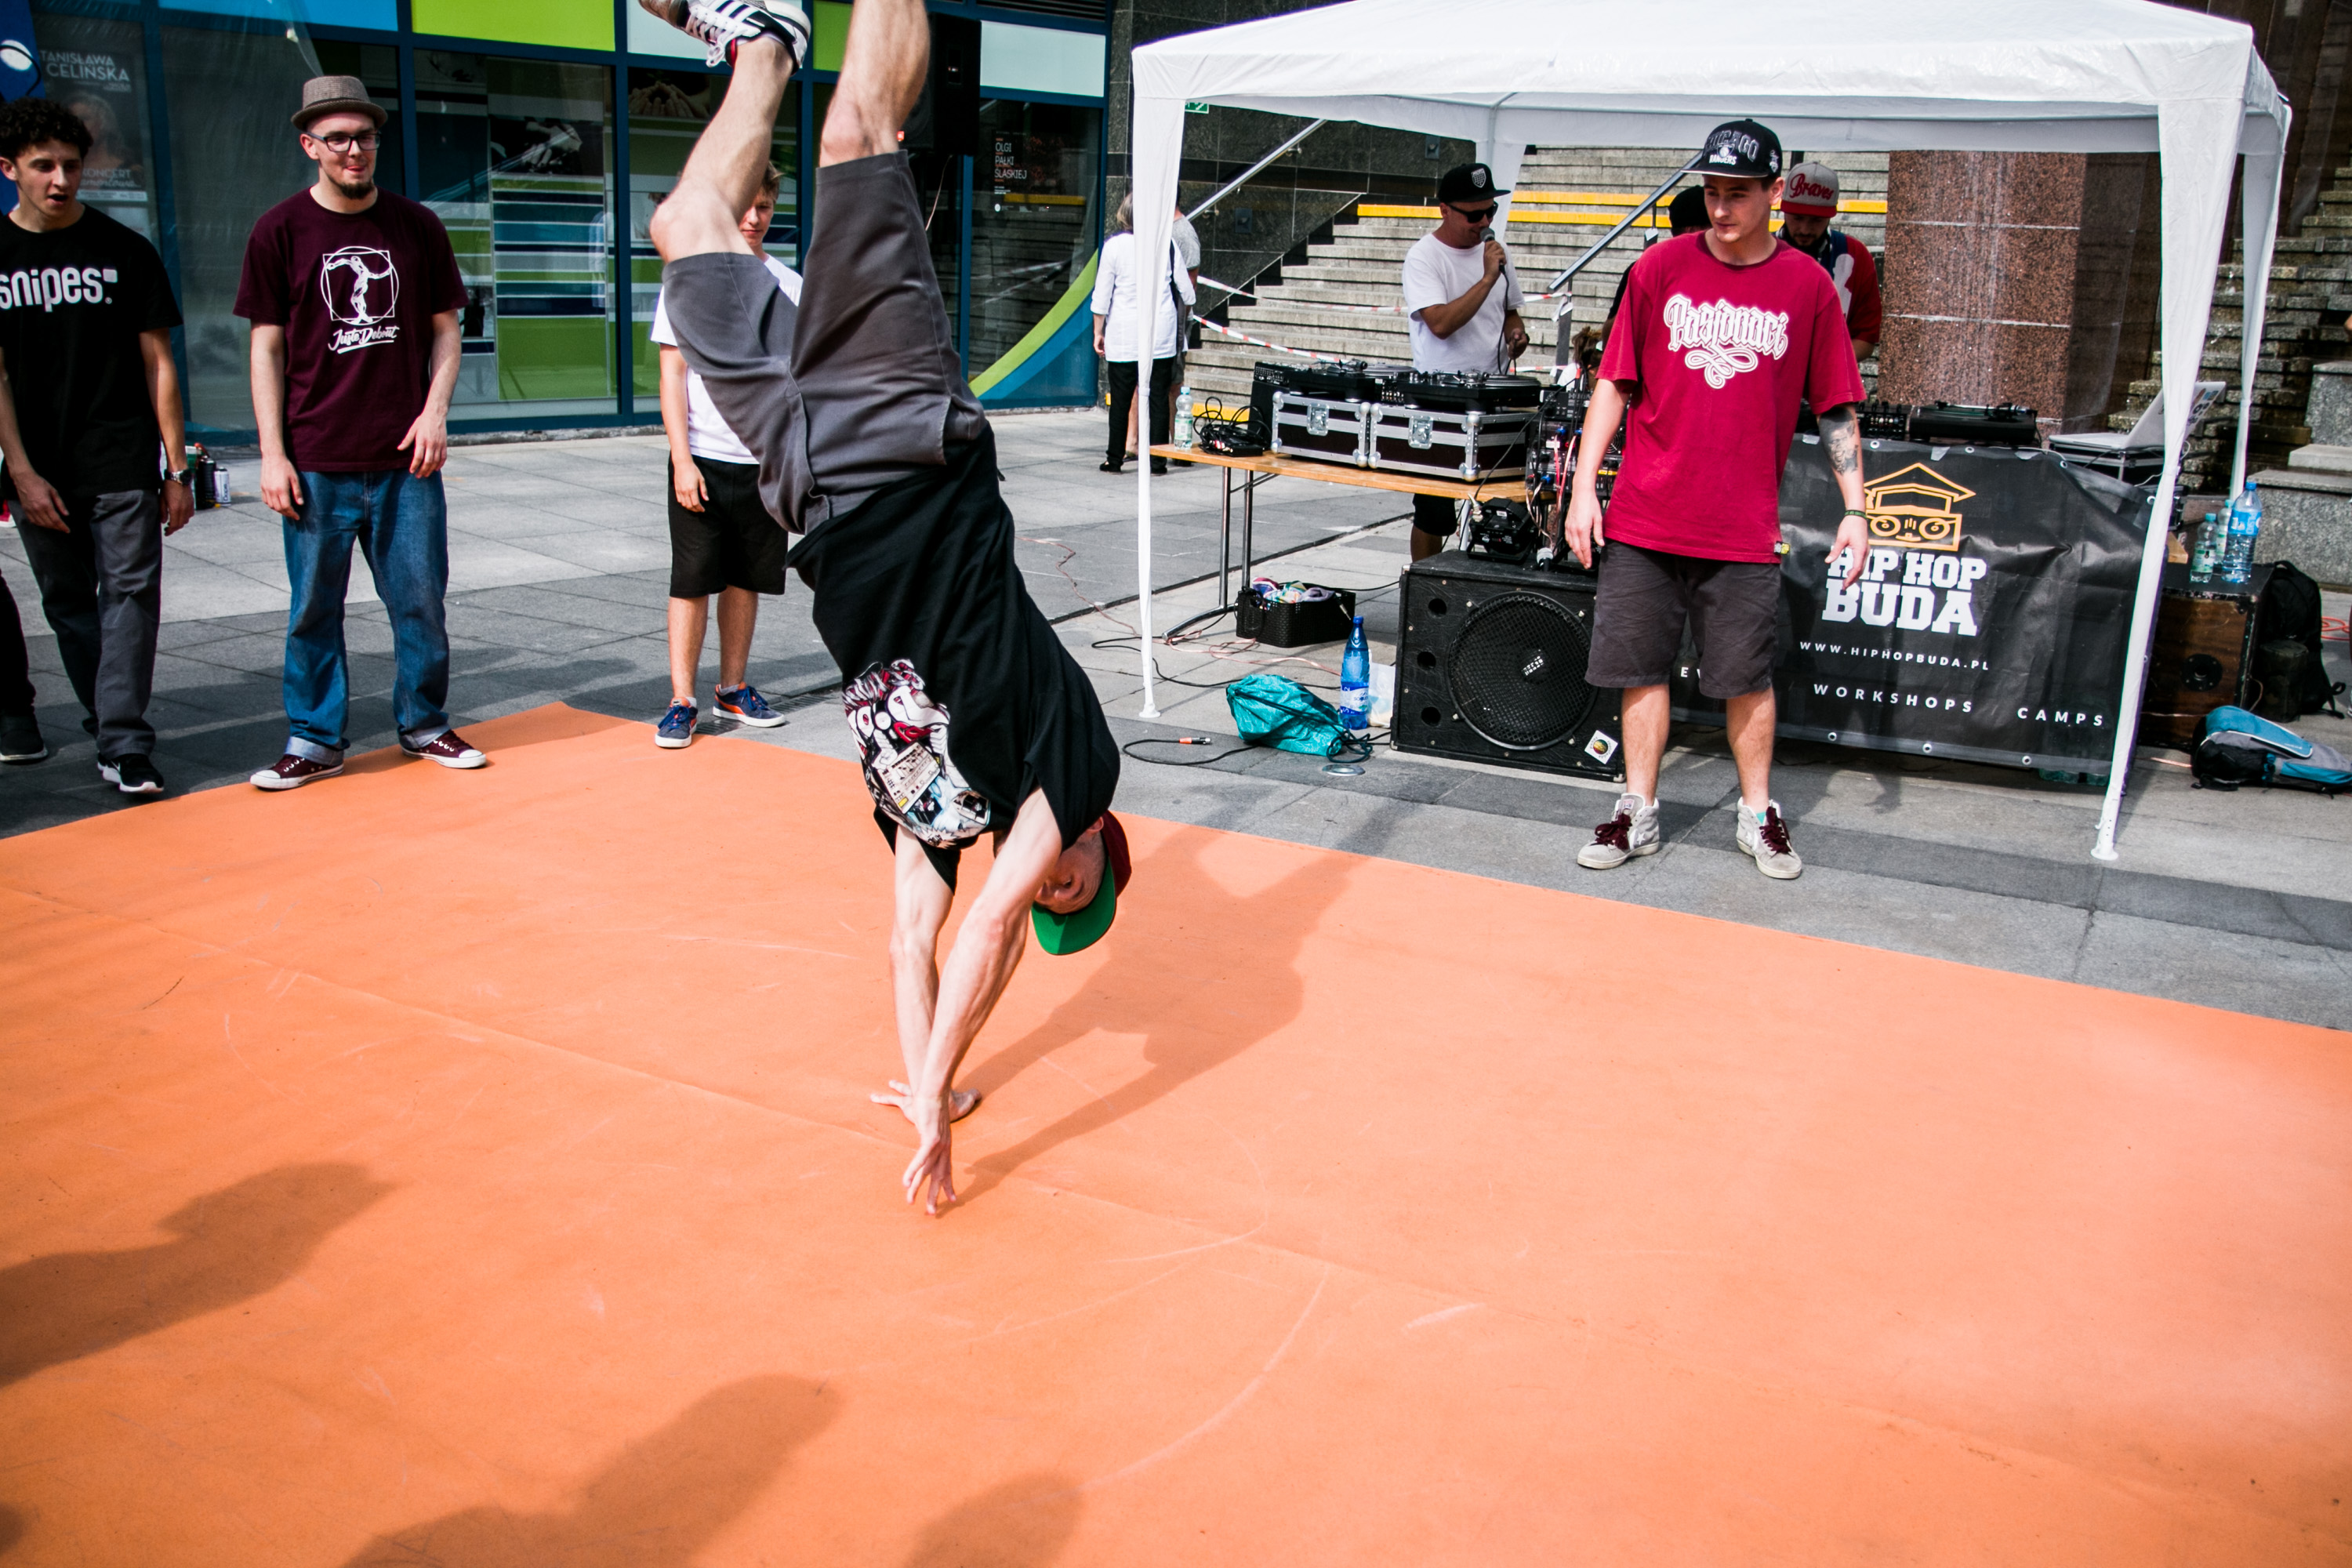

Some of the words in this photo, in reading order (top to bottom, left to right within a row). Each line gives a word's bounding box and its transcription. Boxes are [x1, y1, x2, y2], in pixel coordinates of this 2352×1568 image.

[40, 49, 116, 67] TANISŁAWA
[45, 62, 130, 82] CELIŃSKA
[995, 142, 1012, 153] OLGI
[1790, 172, 1835, 200] Braves
[0, 267, 103, 312] snipes
[1828, 546, 1899, 581] HIP
[1902, 552, 1987, 590] HOP
[1821, 578, 1978, 637] BUDA
[1800, 641, 1989, 670] WWW.HIPHOPBUDA.PL
[1813, 684, 1973, 713] WORKSHOPS
[2017, 707, 2103, 727] CAMPS
